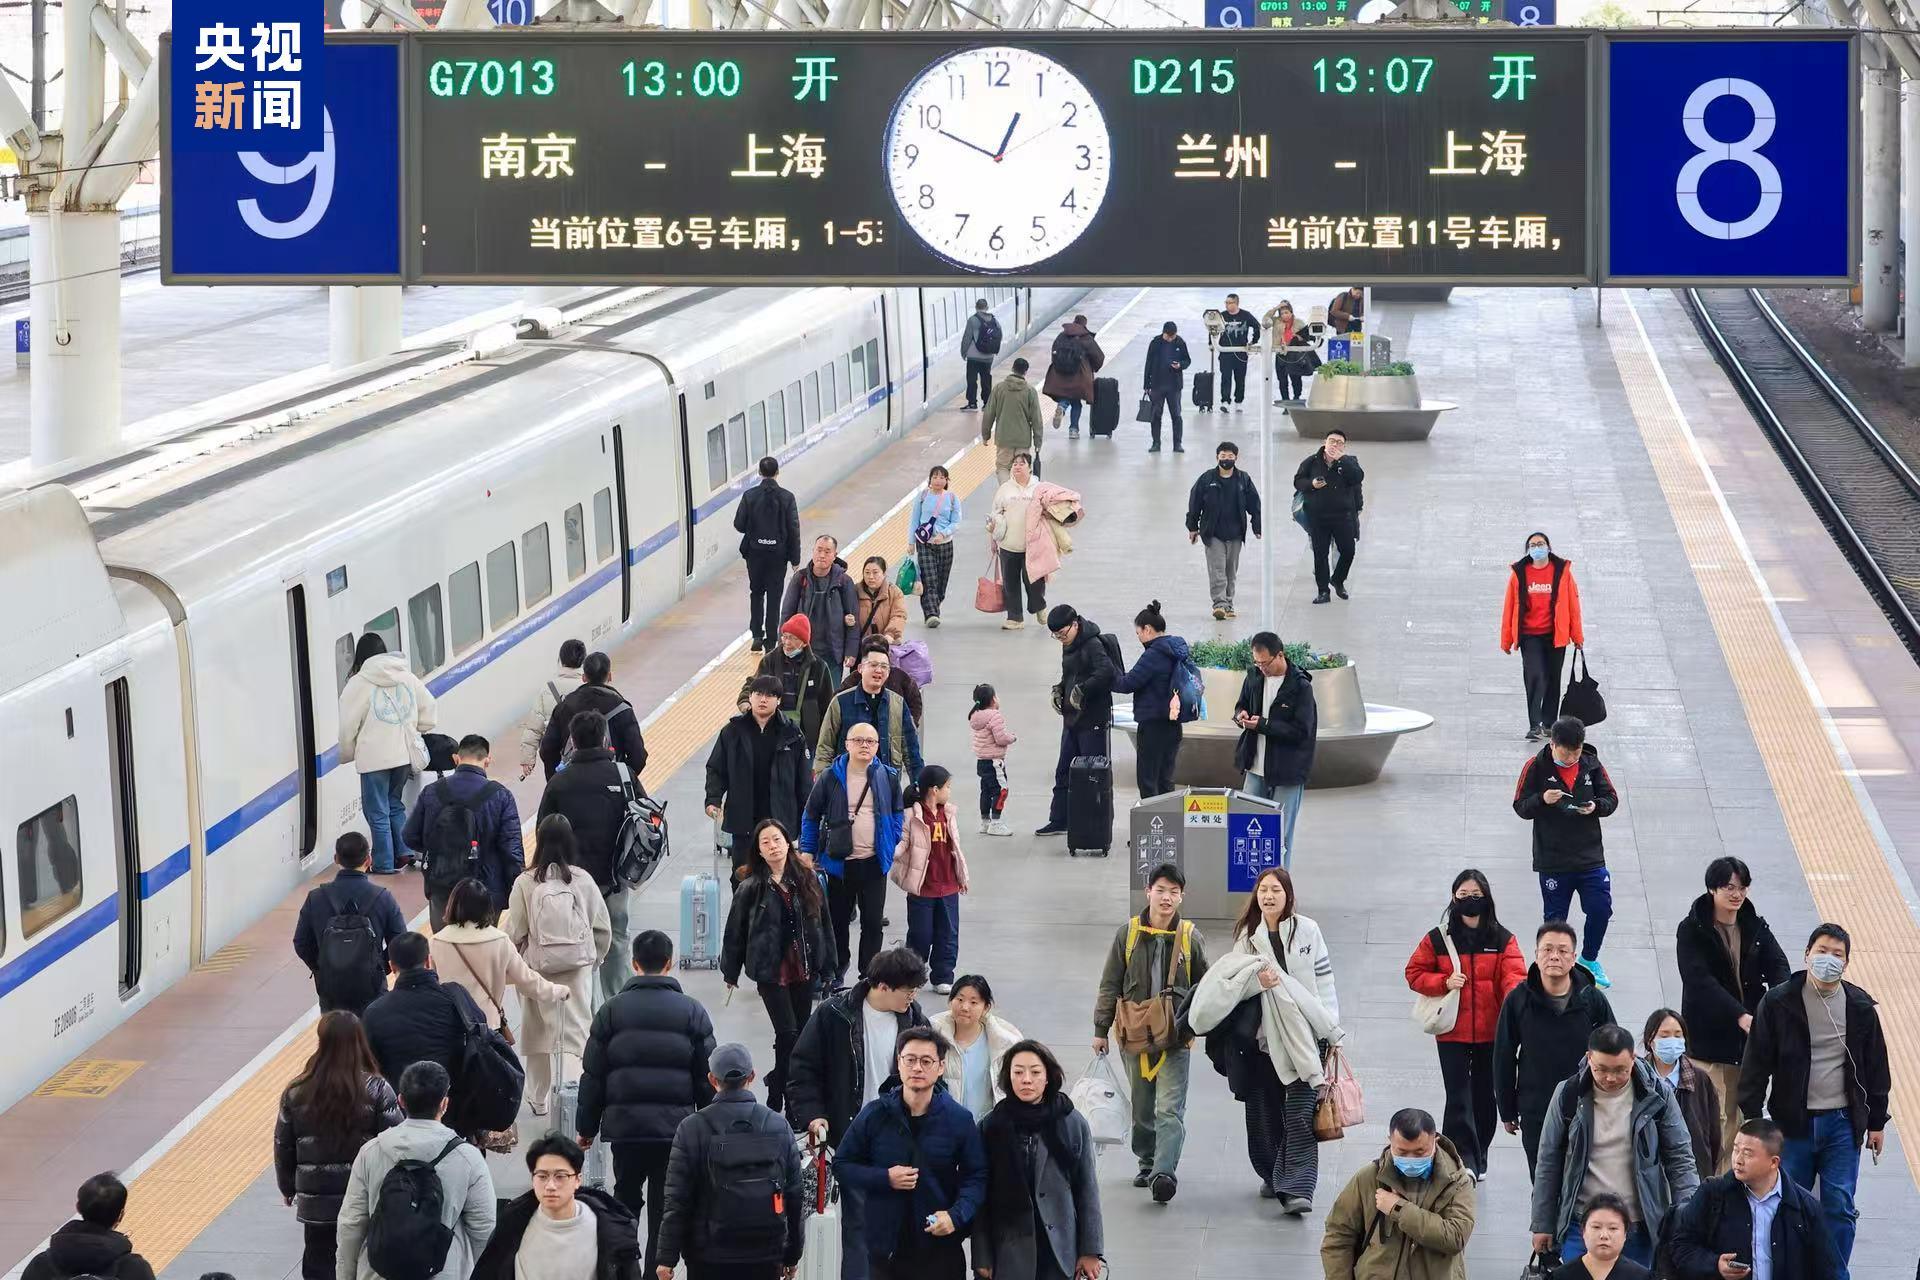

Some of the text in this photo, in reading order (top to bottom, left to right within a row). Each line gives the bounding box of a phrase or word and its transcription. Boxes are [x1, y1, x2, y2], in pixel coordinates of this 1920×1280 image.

[1261, 1, 1288, 11] G7013
[1301, 1, 1327, 11] 13:00
[430, 57, 839, 102] G7013 13:00 开
[985, 61, 1010, 87] 12
[1036, 73, 1043, 98] 1
[1133, 55, 1537, 101] D215 13:07 开
[949, 75, 965, 100] 11
[919, 104, 942, 130] 10
[1062, 101, 1077, 128] 2
[482, 131, 577, 179] 南京
[730, 133, 828, 180] 上海
[904, 144, 919, 169] 9
[1075, 145, 1091, 170] 3
[1174, 133, 1269, 179] 兰州
[1429, 130, 1528, 177] 上海
[1675, 77, 1783, 240] 8
[918, 184, 935, 209] 8
[1060, 187, 1077, 213] 4
[955, 213, 970, 239] 7
[988, 225, 1005, 251] 6
[1030, 216, 1046, 242] 5
[1528, 581, 1552, 591] Jeep
